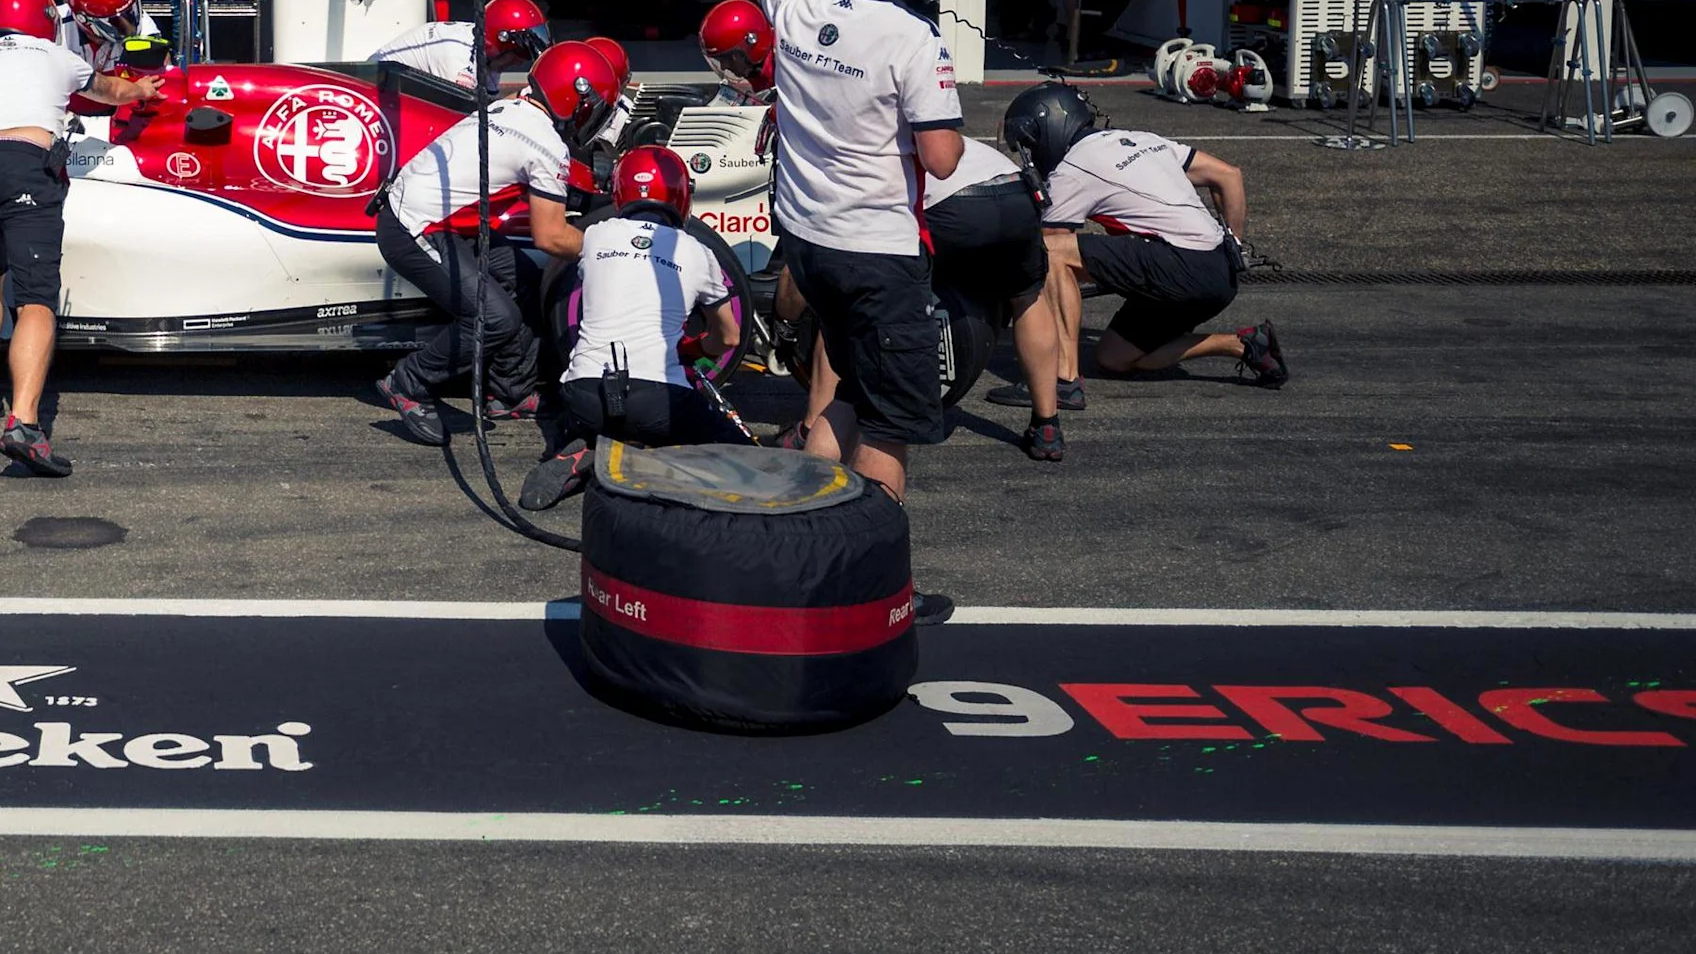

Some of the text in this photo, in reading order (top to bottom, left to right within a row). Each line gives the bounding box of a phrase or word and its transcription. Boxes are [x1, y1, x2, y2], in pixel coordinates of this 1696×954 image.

[779, 38, 813, 63] Sauber
[833, 59, 865, 79] Team
[261, 89, 389, 156] ALFA ROMEO
[719, 158, 760, 168] Sauber
[699, 204, 770, 233] Claro
[596, 249, 630, 261] Sauber
[654, 255, 683, 273] Team
[615, 593, 647, 622] Left
[45, 694, 99, 707] 1873
[907, 679, 1074, 738] 9
